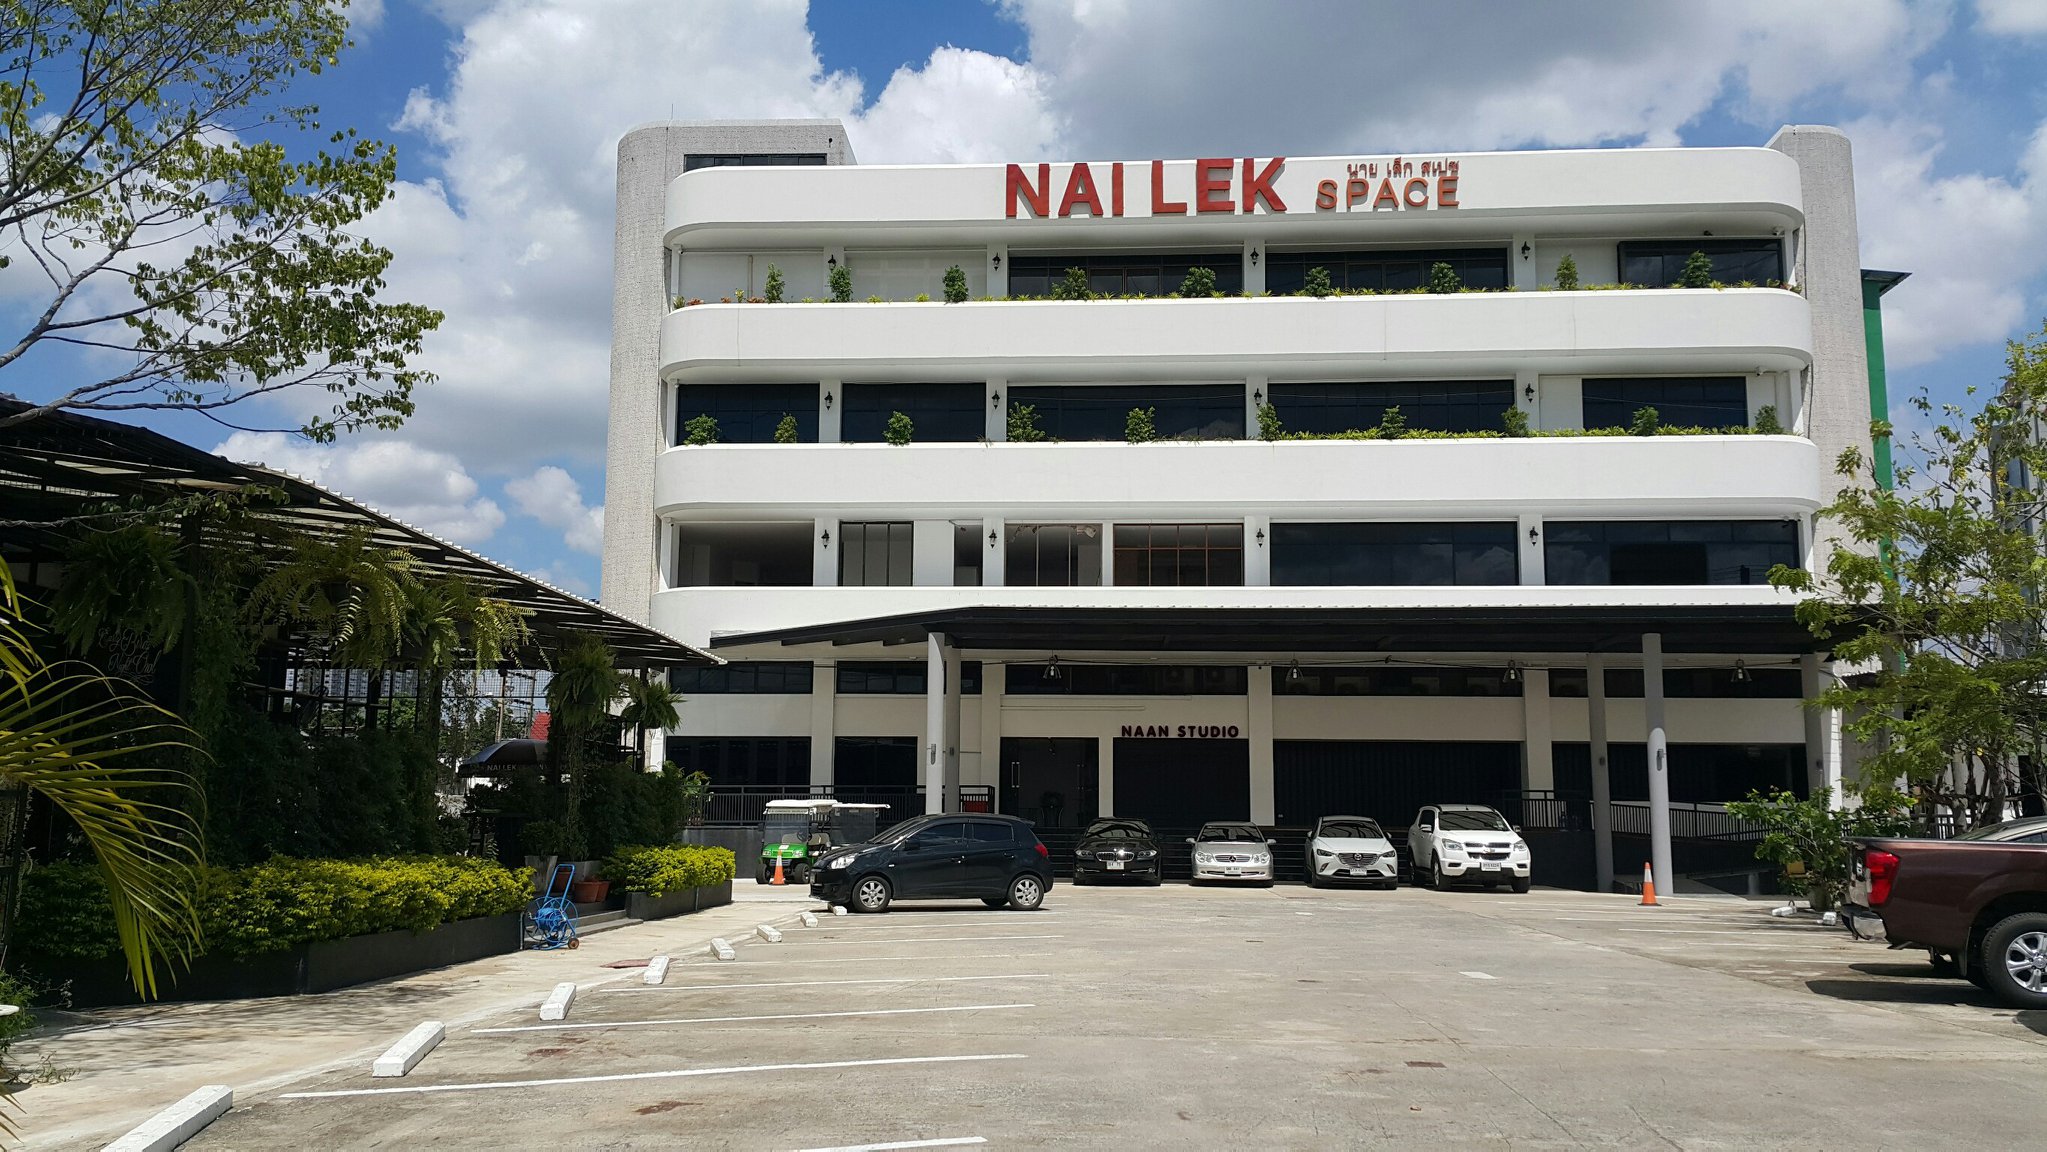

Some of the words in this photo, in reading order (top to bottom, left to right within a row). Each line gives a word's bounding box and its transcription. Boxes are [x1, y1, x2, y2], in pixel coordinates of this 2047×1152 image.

[1387, 156, 1413, 177] เล็ก
[1006, 163, 1123, 216] NAI
[1152, 157, 1287, 214] LEK
[1316, 175, 1459, 208] SPACE
[1121, 725, 1169, 737] NAAN
[1177, 725, 1239, 737] STUDIO
